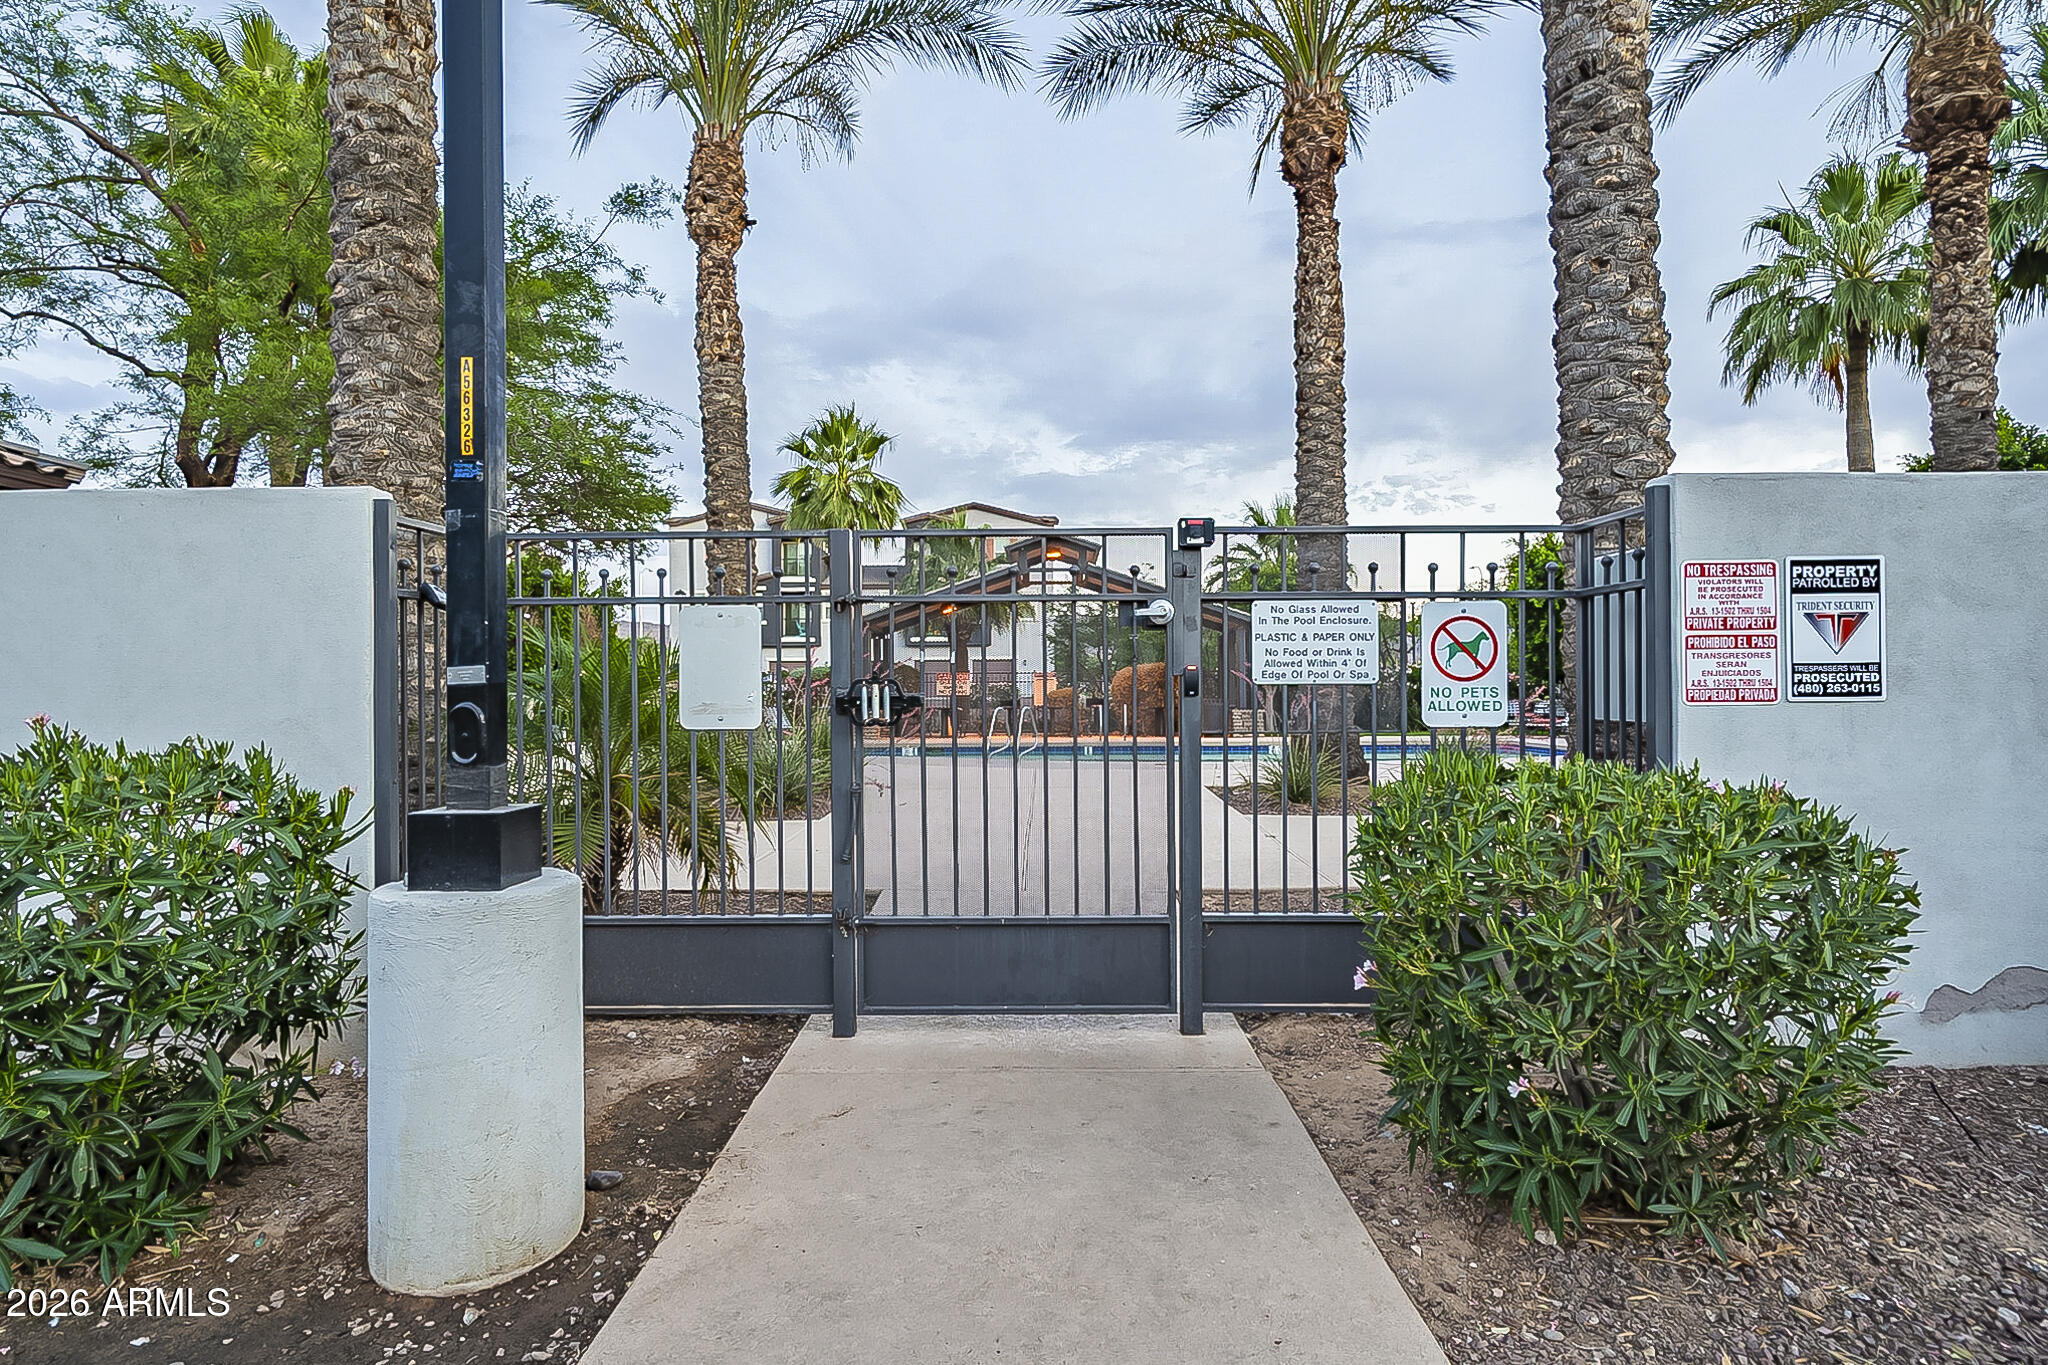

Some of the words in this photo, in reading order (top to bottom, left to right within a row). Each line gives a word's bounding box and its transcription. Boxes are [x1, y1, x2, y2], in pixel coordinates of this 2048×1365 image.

[1687, 564, 1700, 576] NO
[1703, 563, 1774, 576] TRESPASSING
[1792, 565, 1878, 578] PROPERTY
[1792, 578, 1860, 588] PATROLLED
[1862, 577, 1878, 587] BY
[1270, 605, 1284, 614] No
[1288, 605, 1316, 614] Glass
[1320, 605, 1360, 614] Allowed
[1690, 607, 1708, 615] A.R.S.
[1738, 606, 1754, 614] THRU
[1756, 606, 1772, 614] 1504
[1796, 602, 1832, 610] TRIDENT
[1834, 601, 1875, 610] SECURITY
[1294, 616, 1316, 624] Pool
[1320, 616, 1372, 624] Enclosure.
[1687, 618, 1724, 629] PRIVATE
[1726, 617, 1776, 629] PROPERTY
[1254, 633, 1296, 642] PLASTIC
[1301, 633, 1308, 642] &
[1313, 632, 1345, 642] PAPER
[1349, 632, 1376, 642] ONLY
[1688, 636, 1735, 648] PROHIBIDO
[1738, 636, 1749, 648] EL
[1751, 636, 1776, 648] PASO
[1264, 648, 1278, 656] No
[1282, 648, 1308, 656] Food
[1326, 648, 1352, 656] Drink
[1356, 648, 1366, 656] Is
[1264, 660, 1302, 668] Allowed
[1306, 659, 1337, 668] Within
[1355, 659, 1366, 668] Of
[1262, 670, 1287, 680] Edge
[1291, 670, 1303, 678] Of
[1308, 670, 1330, 678] Pool
[1333, 670, 1346, 678] Or
[1350, 670, 1370, 680] Spa
[1794, 672, 1880, 682] PROSECUTED
[1430, 686, 1452, 698] NO
[1461, 686, 1499, 698] PETS
[1688, 689, 1736, 700] PROPIEDAD
[1738, 688, 1776, 700] PRIVADA
[1794, 684, 1824, 695] (480)
[1826, 684, 1880, 692] 263-0115
[1428, 700, 1502, 712] ALLOWED
